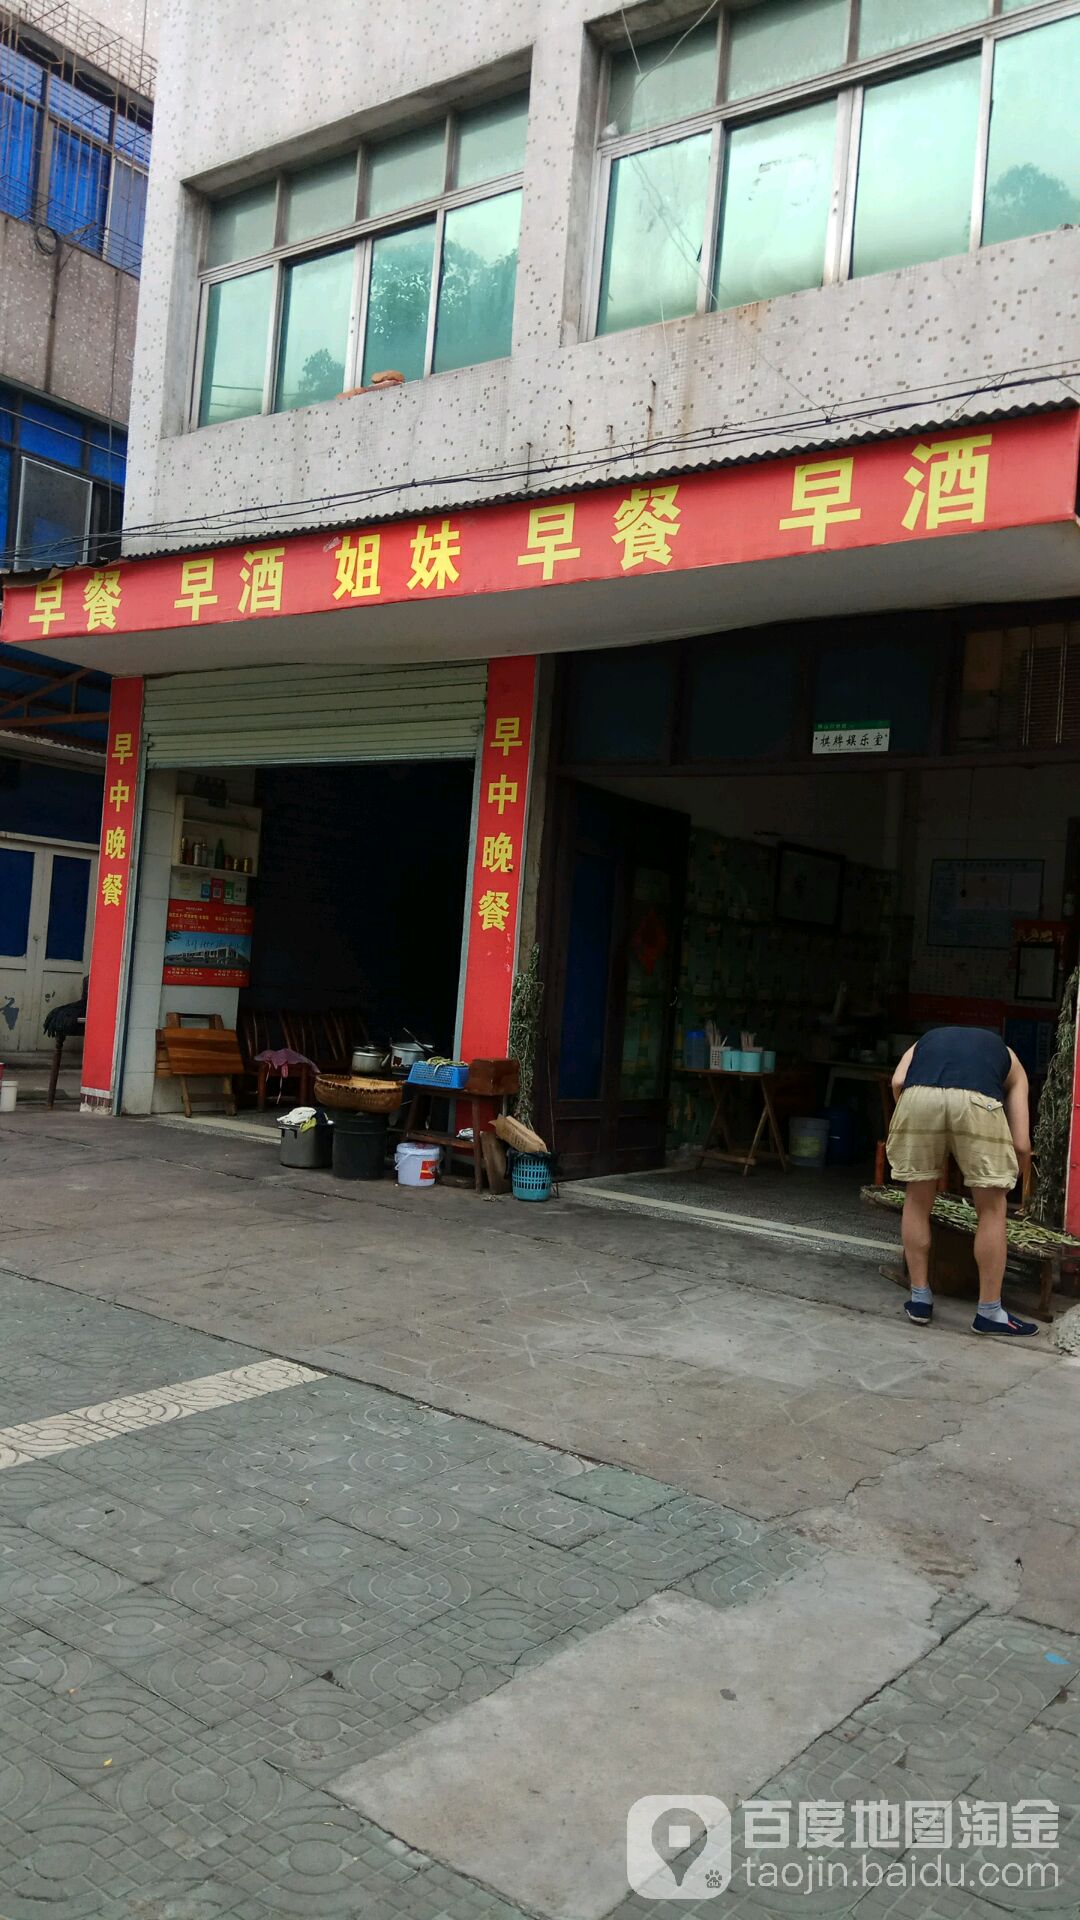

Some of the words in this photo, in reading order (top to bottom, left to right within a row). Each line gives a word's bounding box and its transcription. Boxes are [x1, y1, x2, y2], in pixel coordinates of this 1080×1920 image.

[28, 570, 122, 635] 早餐
[174, 546, 286, 622] 早酒
[332, 519, 462, 601] 姐妹
[517, 484, 682, 581] 早餐
[779, 433, 993, 546] 早酒
[101, 733, 134, 906] 早中晚餐
[478, 717, 523, 932] 早中晚餐
